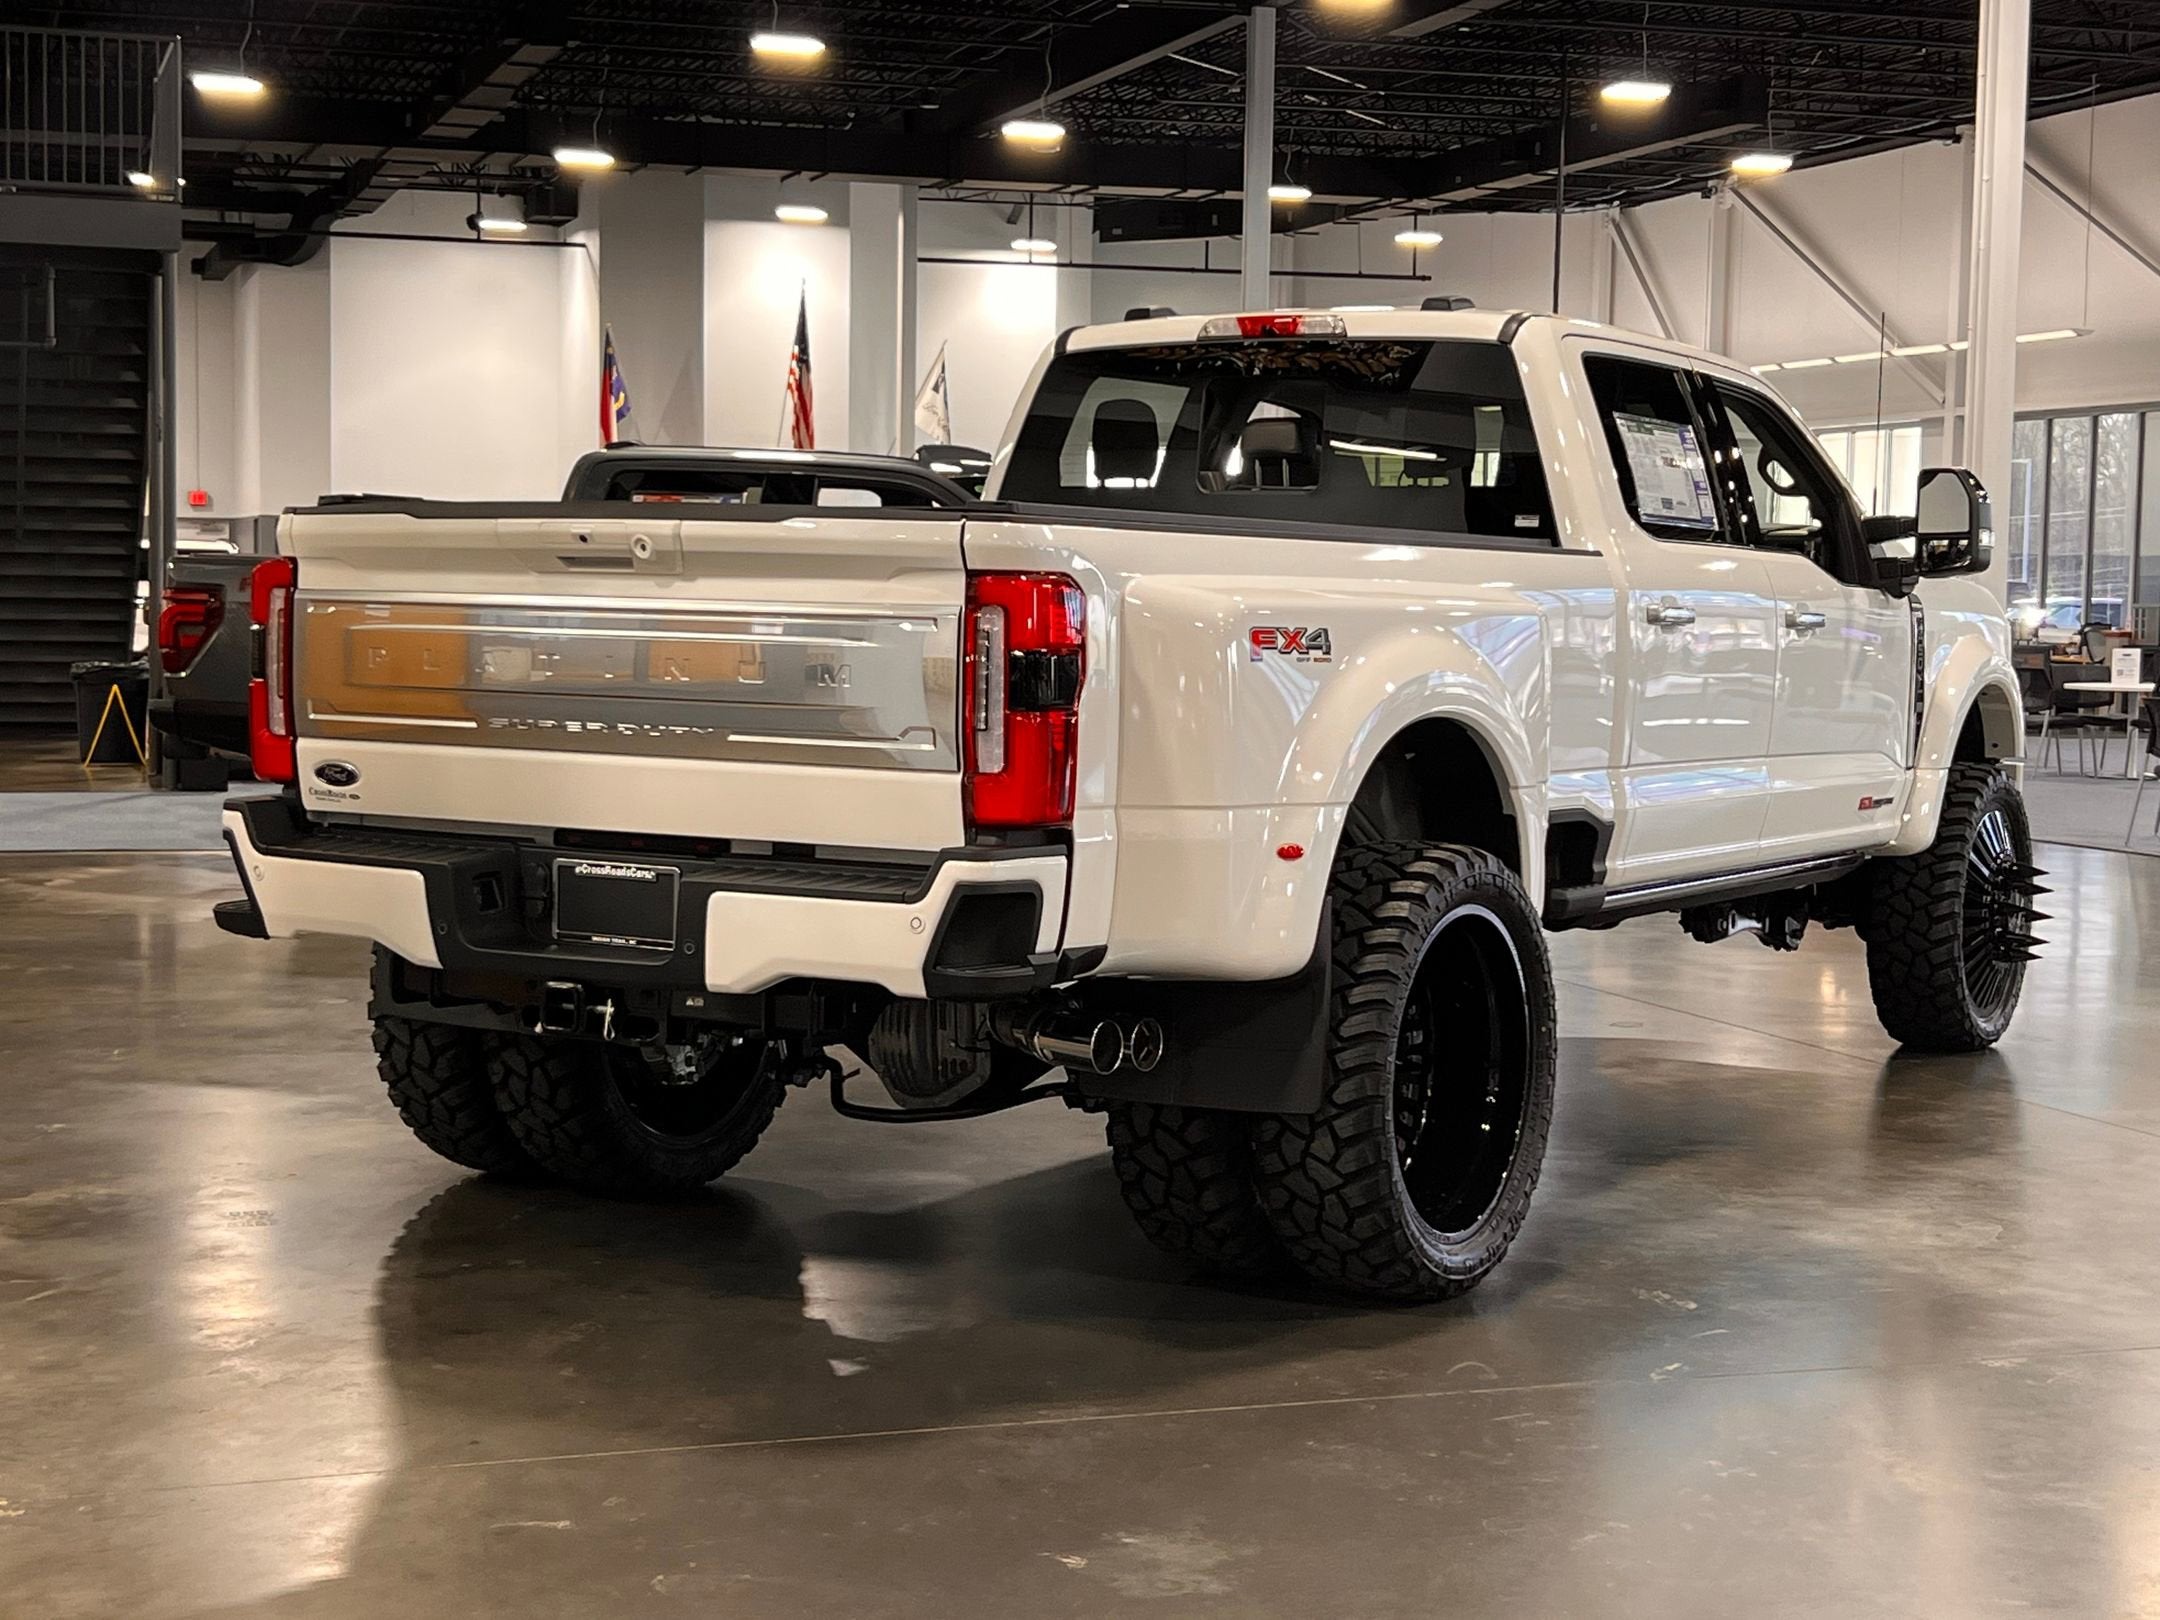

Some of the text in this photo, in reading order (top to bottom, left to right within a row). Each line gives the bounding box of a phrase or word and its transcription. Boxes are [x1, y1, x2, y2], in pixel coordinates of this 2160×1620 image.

[1249, 626, 1331, 662] FX4
[367, 646, 852, 688] PLATINUM
[488, 717, 716, 739] SUPER DUTY
